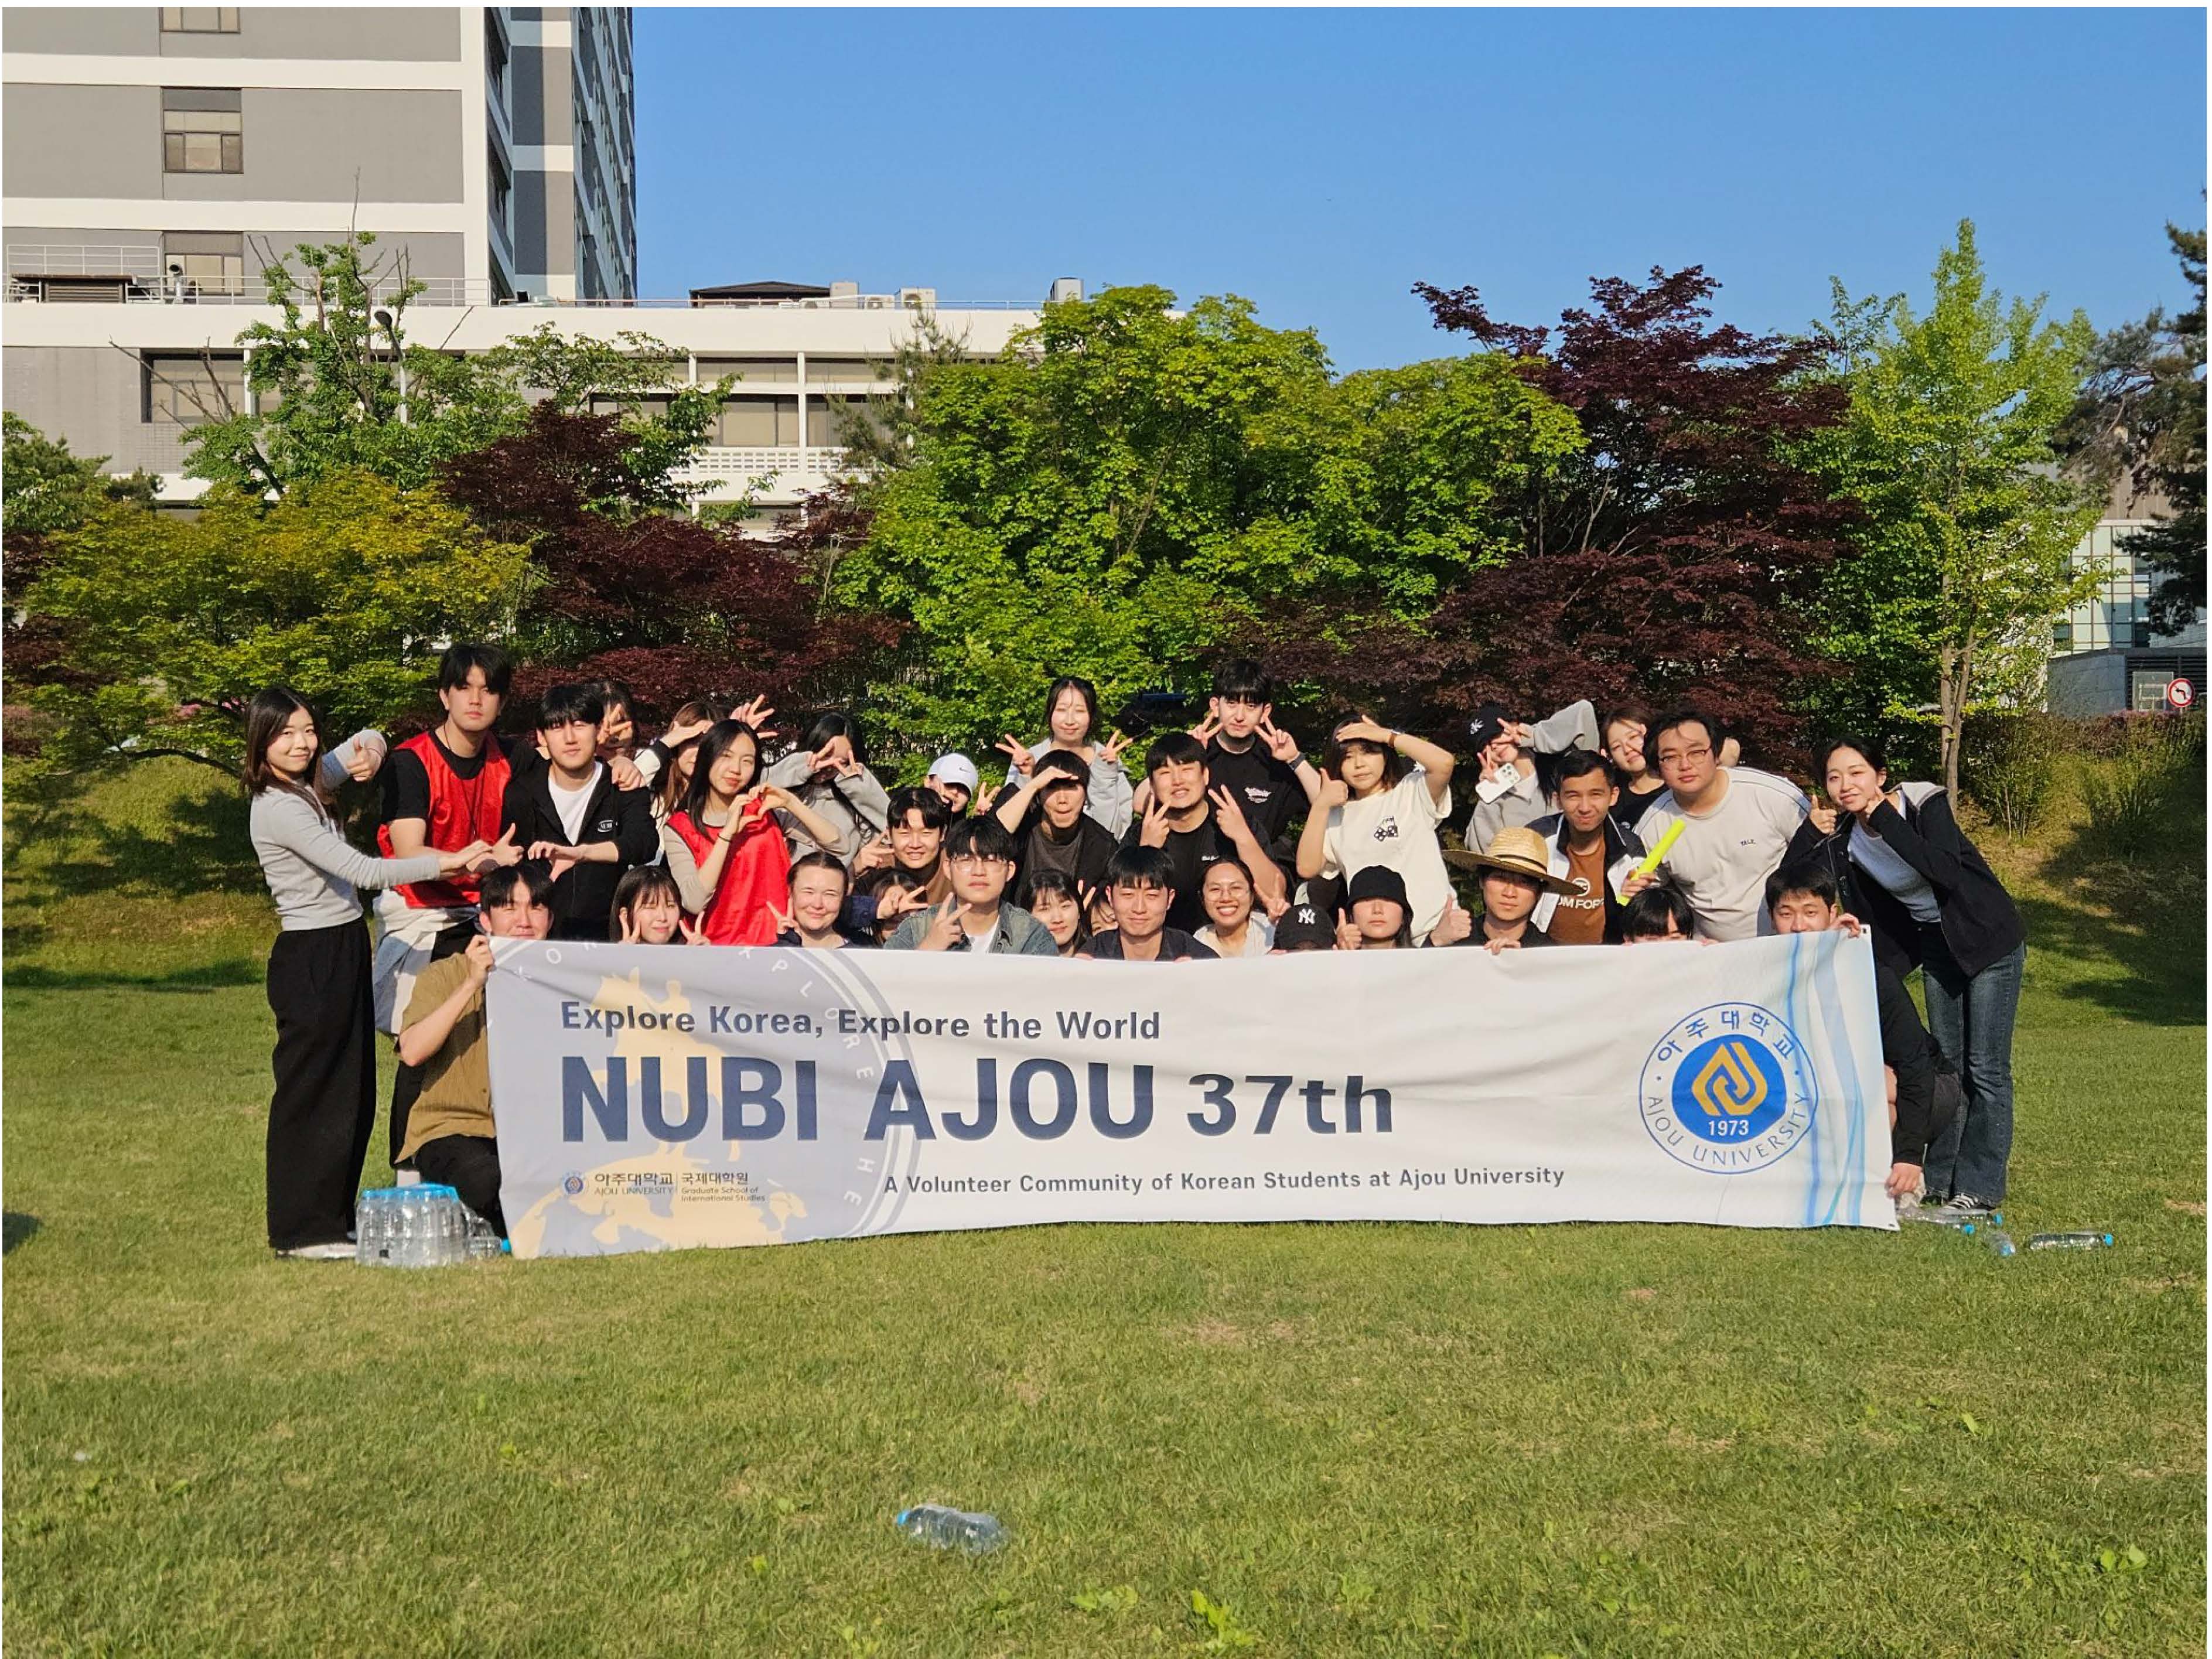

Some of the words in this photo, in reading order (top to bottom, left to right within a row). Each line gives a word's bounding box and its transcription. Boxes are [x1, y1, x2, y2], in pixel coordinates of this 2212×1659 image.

[1298, 908, 1315, 924] NY
[562, 1001, 695, 1037] Explore
[710, 1006, 823, 1038] Korea,
[838, 1009, 970, 1041] Explore
[984, 1011, 1041, 1039] the
[1056, 1012, 1160, 1039] World
[1657, 1010, 1796, 1061] 아주대학교
[562, 1056, 817, 1142] NUBI
[863, 1058, 1154, 1140] AJOU
[1187, 1073, 1392, 1136] 37th
[1646, 1096, 1684, 1146] AJOU
[1692, 1093, 1811, 1165] UNIVERSITY
[1708, 1119, 1749, 1136] 1973
[595, 1172, 673, 1186] 아주대학교
[681, 1172, 749, 1185] 국제대학원
[884, 1176, 898, 1193] A
[907, 1176, 1011, 1193] Volunteer
[1020, 1174, 1143, 1195] Community
[1152, 1173, 1173, 1190] of
[1182, 1173, 1255, 1189] Korean
[1264, 1171, 1360, 1189] Students
[1370, 1171, 1390, 1187] at
[1400, 1169, 1445, 1190] Ajou
[1454, 1167, 1565, 1187] University
[595, 1187, 618, 1196] AJOU
[622, 1186, 674, 1196] UNIVERSITY
